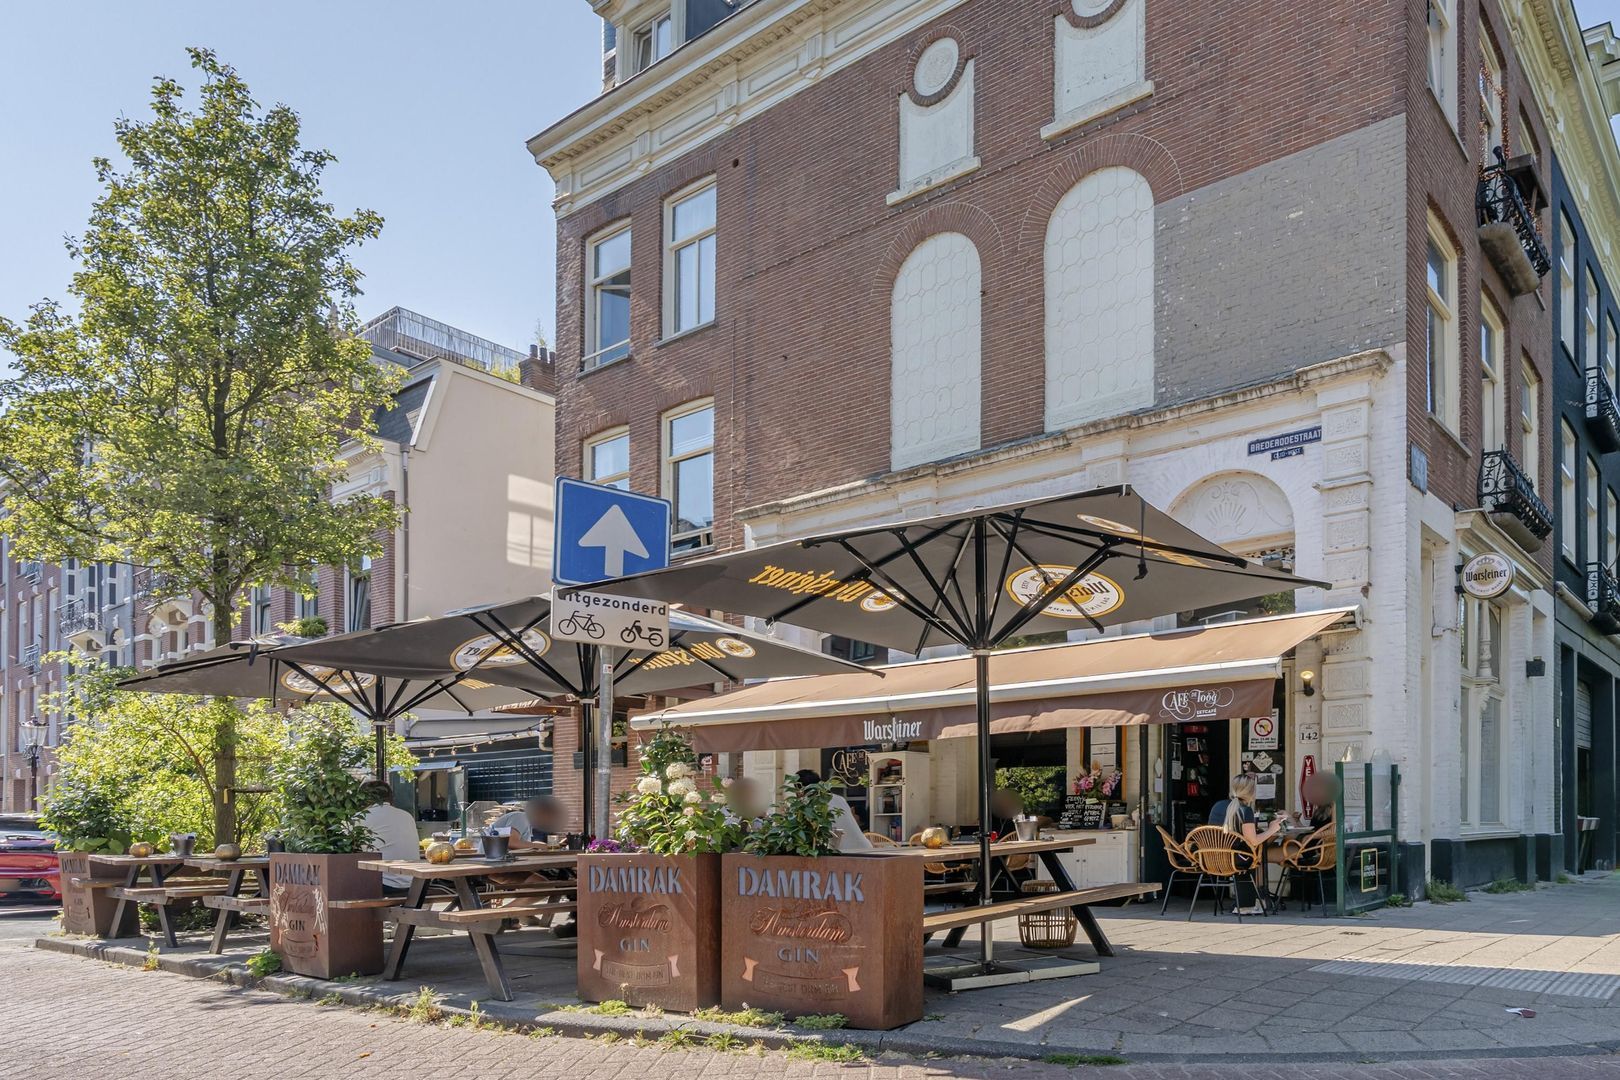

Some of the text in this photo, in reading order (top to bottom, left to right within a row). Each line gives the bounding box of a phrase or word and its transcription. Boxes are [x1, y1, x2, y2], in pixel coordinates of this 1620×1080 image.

[1250, 429, 1321, 453] BREDERODESTRAAT
[1465, 568, 1507, 582] Warsteiner
[564, 592, 666, 616] itgezonderd
[864, 717, 922, 741] Warsteiner
[1300, 732, 1319, 741] 142
[589, 865, 682, 895] DAMRAK
[738, 867, 864, 902] DAMRAK
[600, 903, 673, 932] Amsterdam
[752, 908, 849, 942] Amsterdam
[619, 937, 650, 953] GIN
[777, 945, 819, 964] GIN
